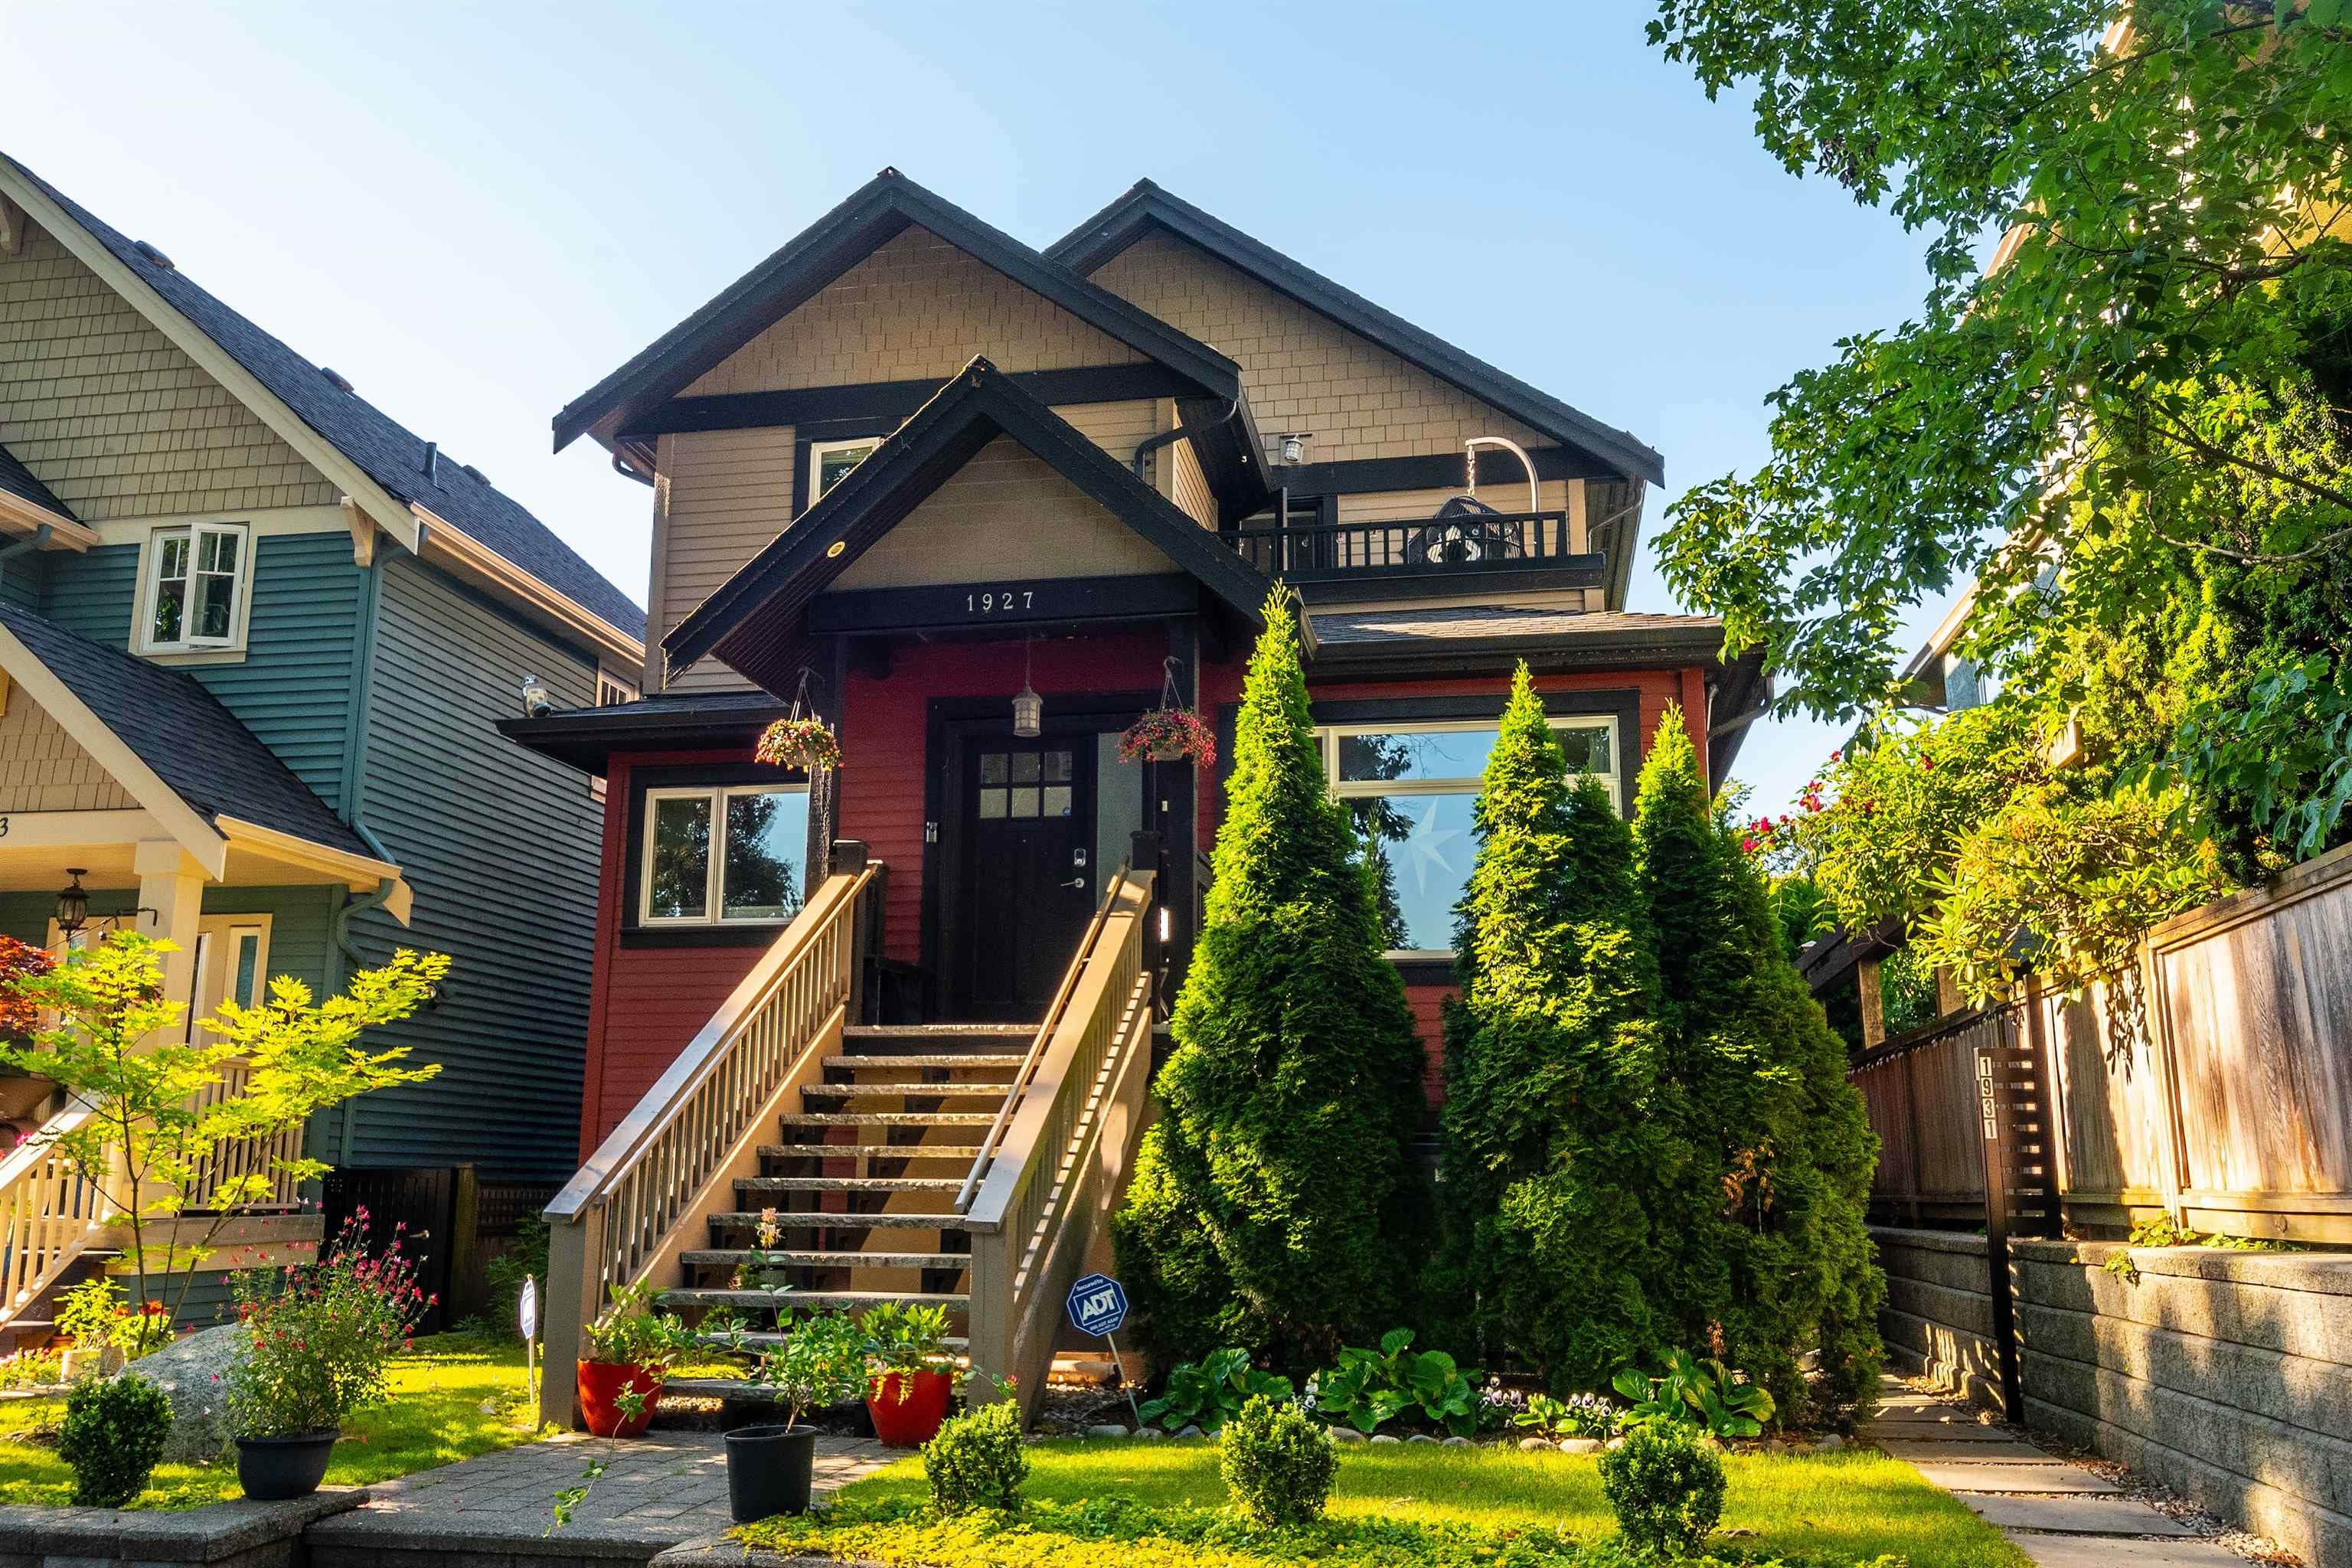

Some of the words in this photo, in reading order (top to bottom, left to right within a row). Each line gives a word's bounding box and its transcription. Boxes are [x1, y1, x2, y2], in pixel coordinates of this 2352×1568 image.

[967, 592, 1033, 611] 1927
[1983, 1058, 1994, 1138] 1931
[1083, 1289, 1116, 1321] ADT
